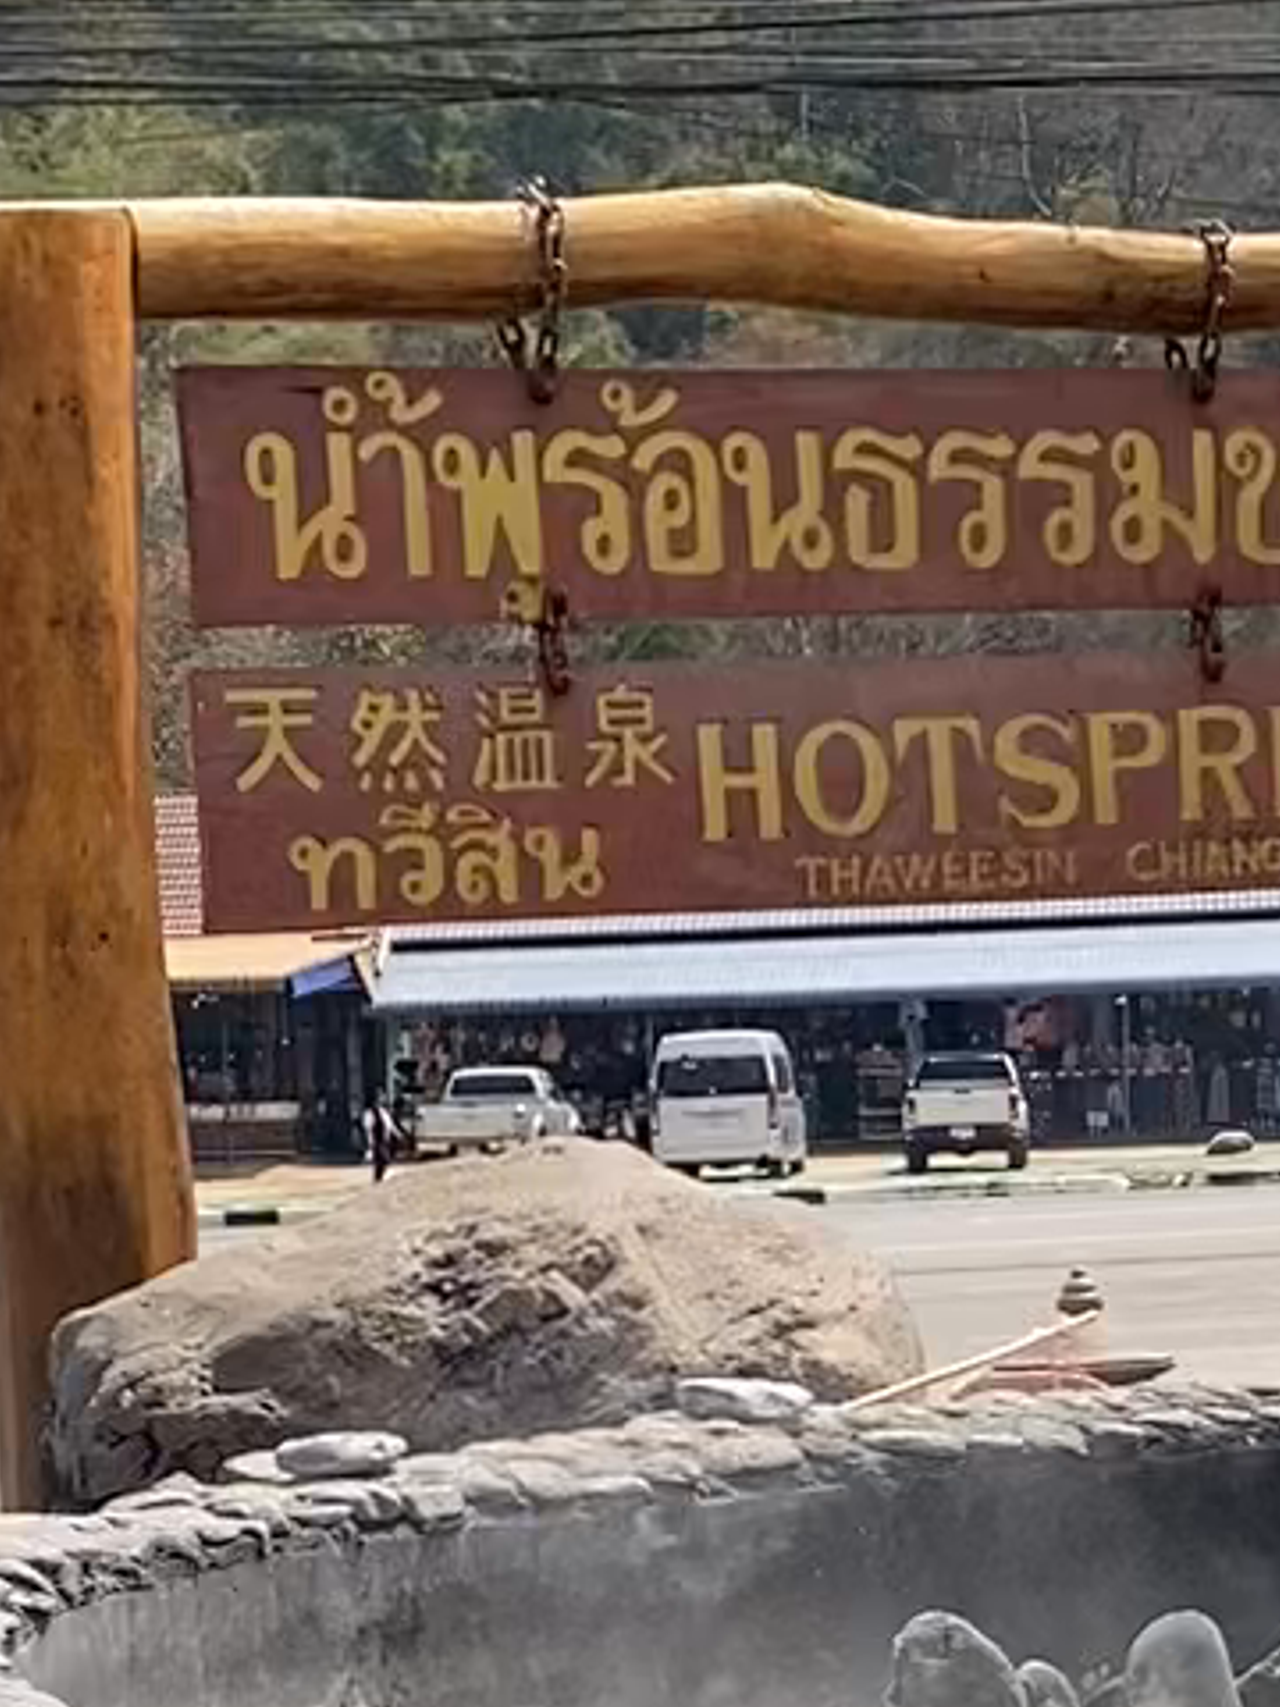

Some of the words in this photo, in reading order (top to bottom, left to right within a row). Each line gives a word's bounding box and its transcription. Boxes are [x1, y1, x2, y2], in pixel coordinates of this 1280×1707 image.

[223, 683, 675, 793] 天然温泉
[287, 799, 606, 911] ทวีสิน
